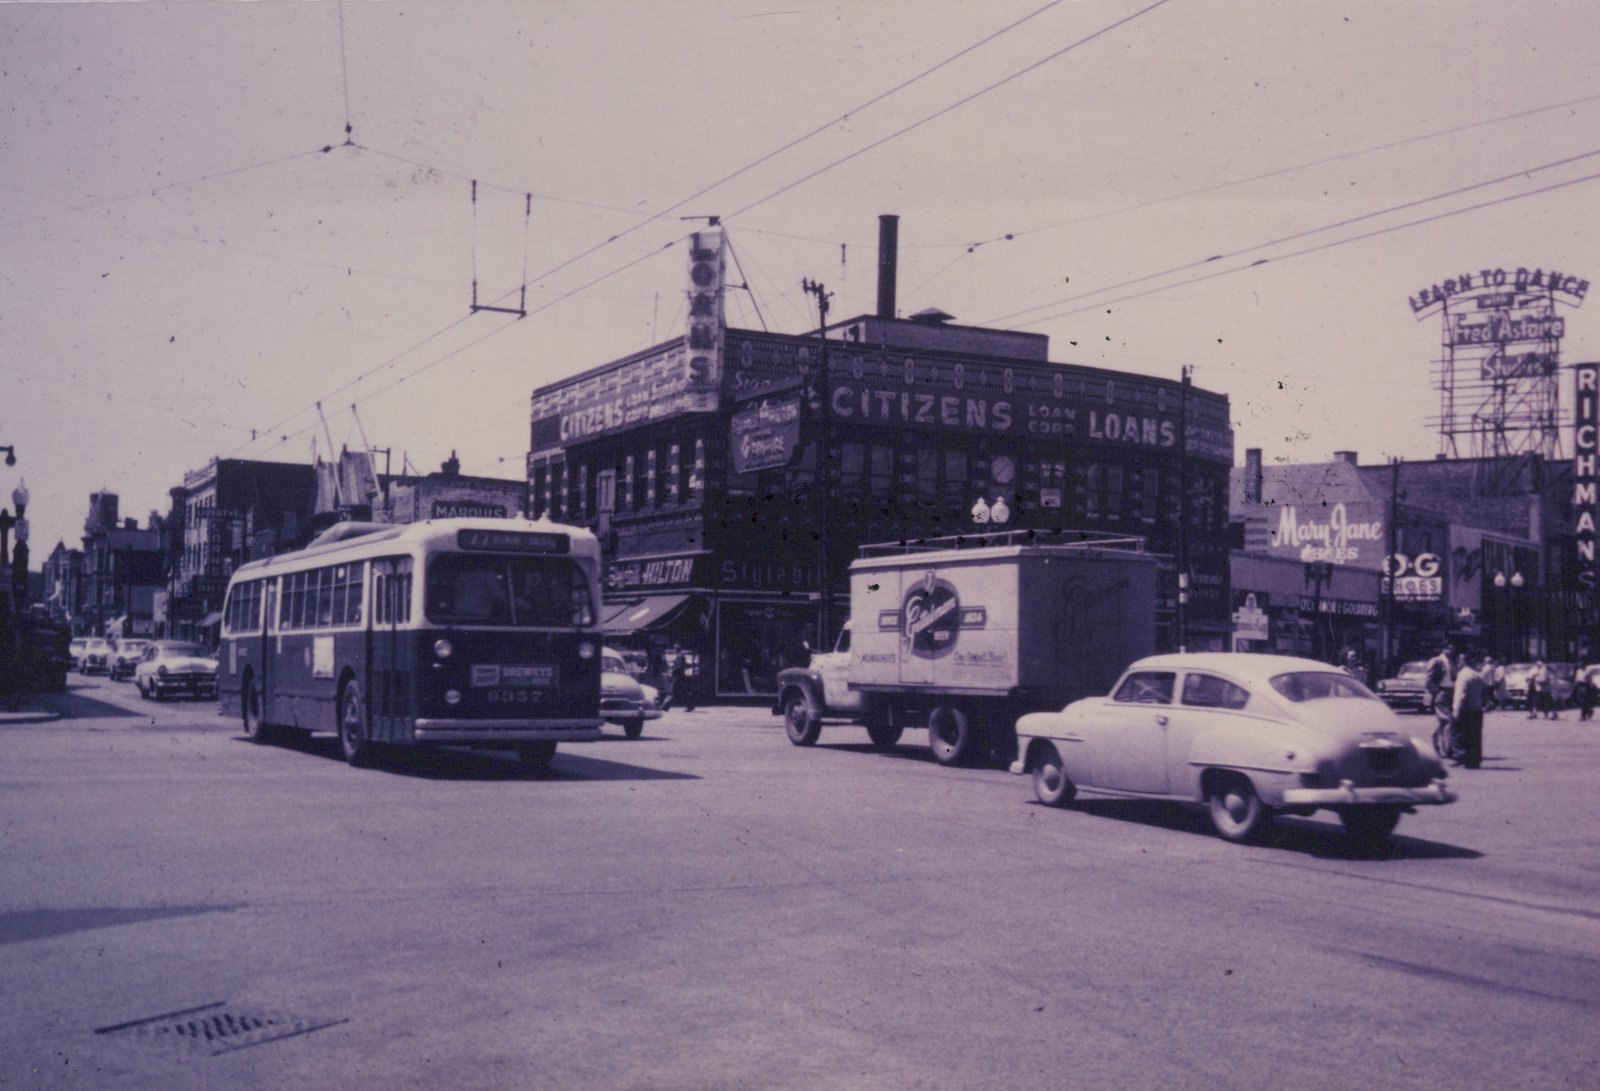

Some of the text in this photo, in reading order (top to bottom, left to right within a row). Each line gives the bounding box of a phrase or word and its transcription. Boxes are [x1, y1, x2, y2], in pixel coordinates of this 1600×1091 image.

[690, 232, 715, 382] LOANS
[1408, 267, 1590, 312] LEARN TO DANCE
[1452, 310, 1565, 342] Fred Astaire
[561, 398, 624, 441] CITIZENS
[832, 386, 1012, 430] CITIZENS
[1028, 405, 1077, 421] LOAN
[1089, 410, 1175, 447] LOANS
[436, 505, 503, 518] MARQUIS
[1272, 503, 1382, 548] Mary Jane
[643, 559, 693, 584] HILTON
